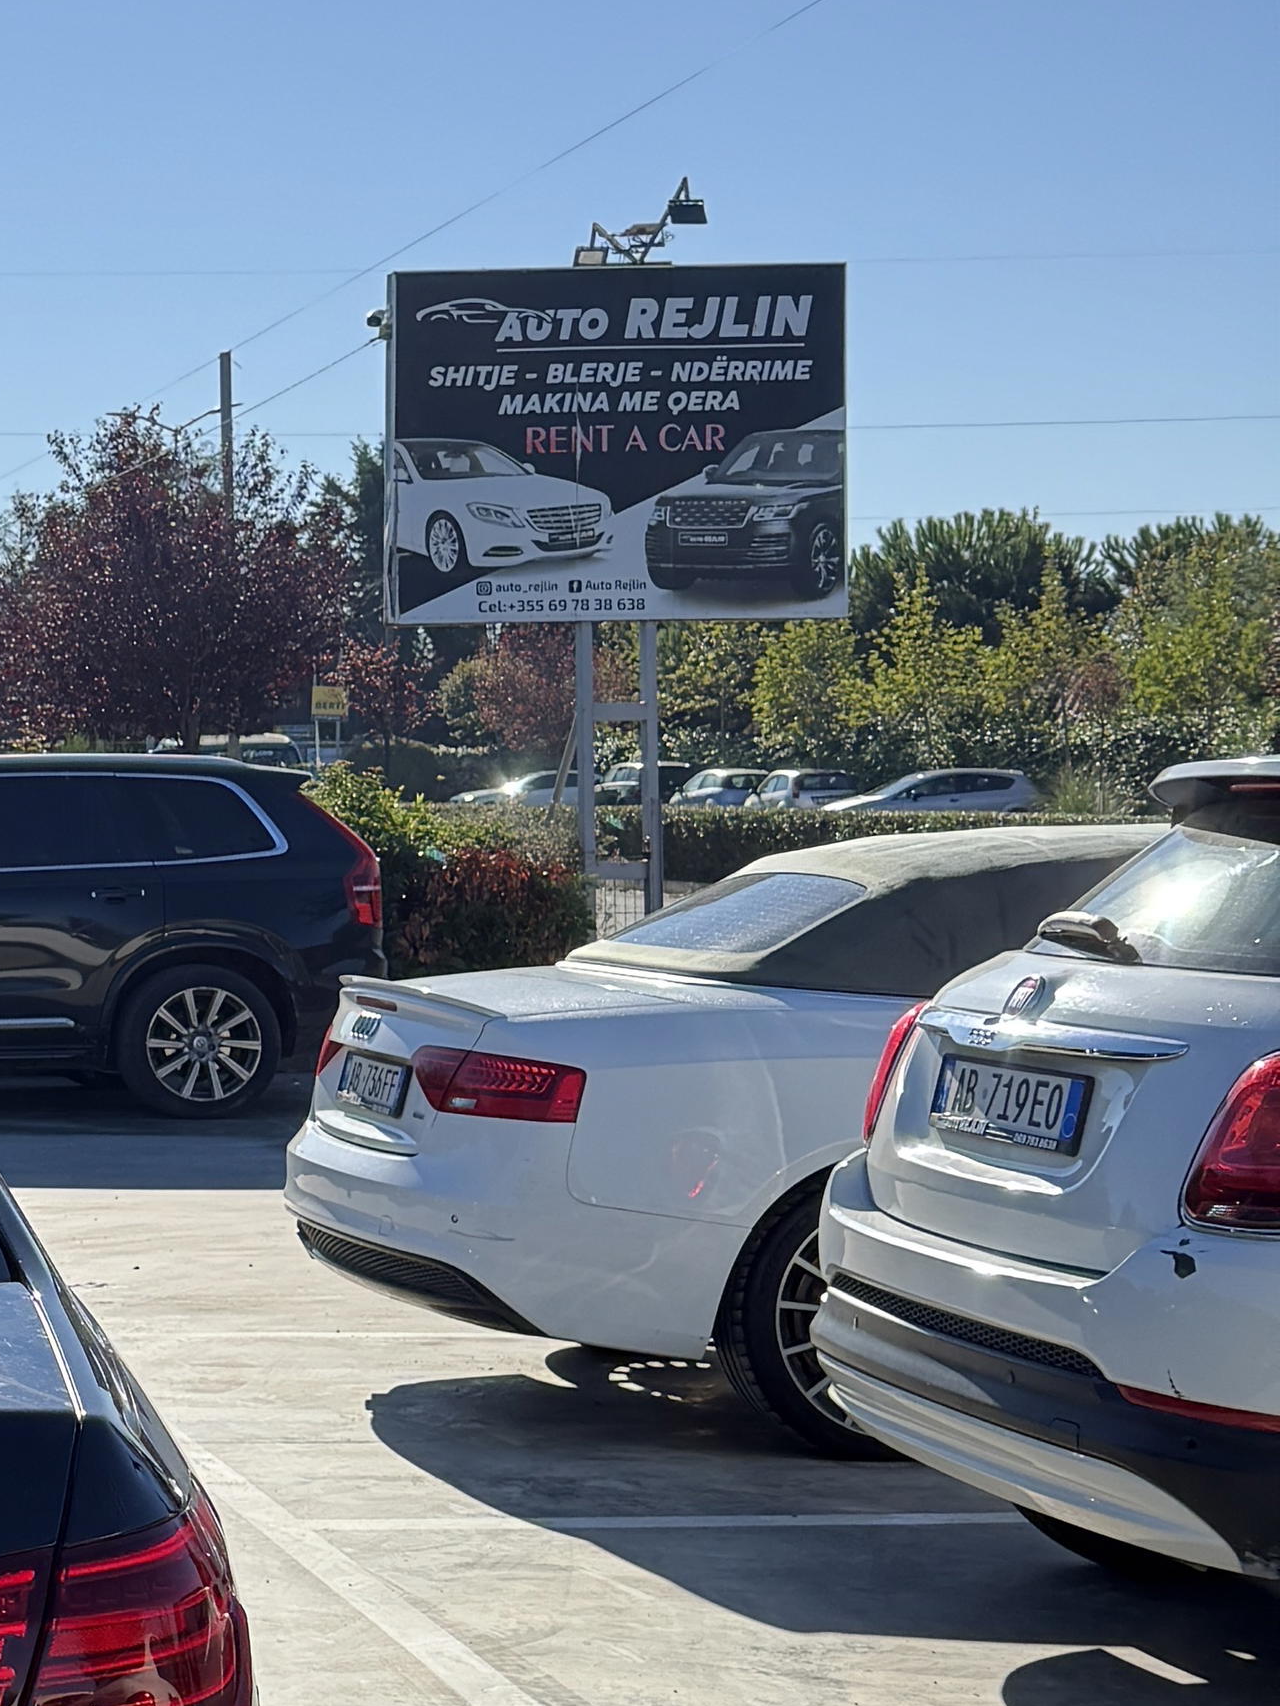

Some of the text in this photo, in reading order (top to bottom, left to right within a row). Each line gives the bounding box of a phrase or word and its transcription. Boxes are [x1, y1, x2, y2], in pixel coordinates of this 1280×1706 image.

[495, 295, 813, 342] AUTO REJLIN
[428, 365, 518, 391] SHITJE
[546, 362, 643, 387] BLERJE
[671, 355, 813, 382] NDËRRIME
[498, 390, 741, 416] MAKINA ME QERA
[526, 423, 726, 455] RENT A CAR
[495, 580, 558, 594] auto_rejlin
[585, 579, 647, 592] Auto Rejlin
[478, 597, 646, 613] Cel:+355 69 78 38 638
[951, 1067, 979, 1115] AB
